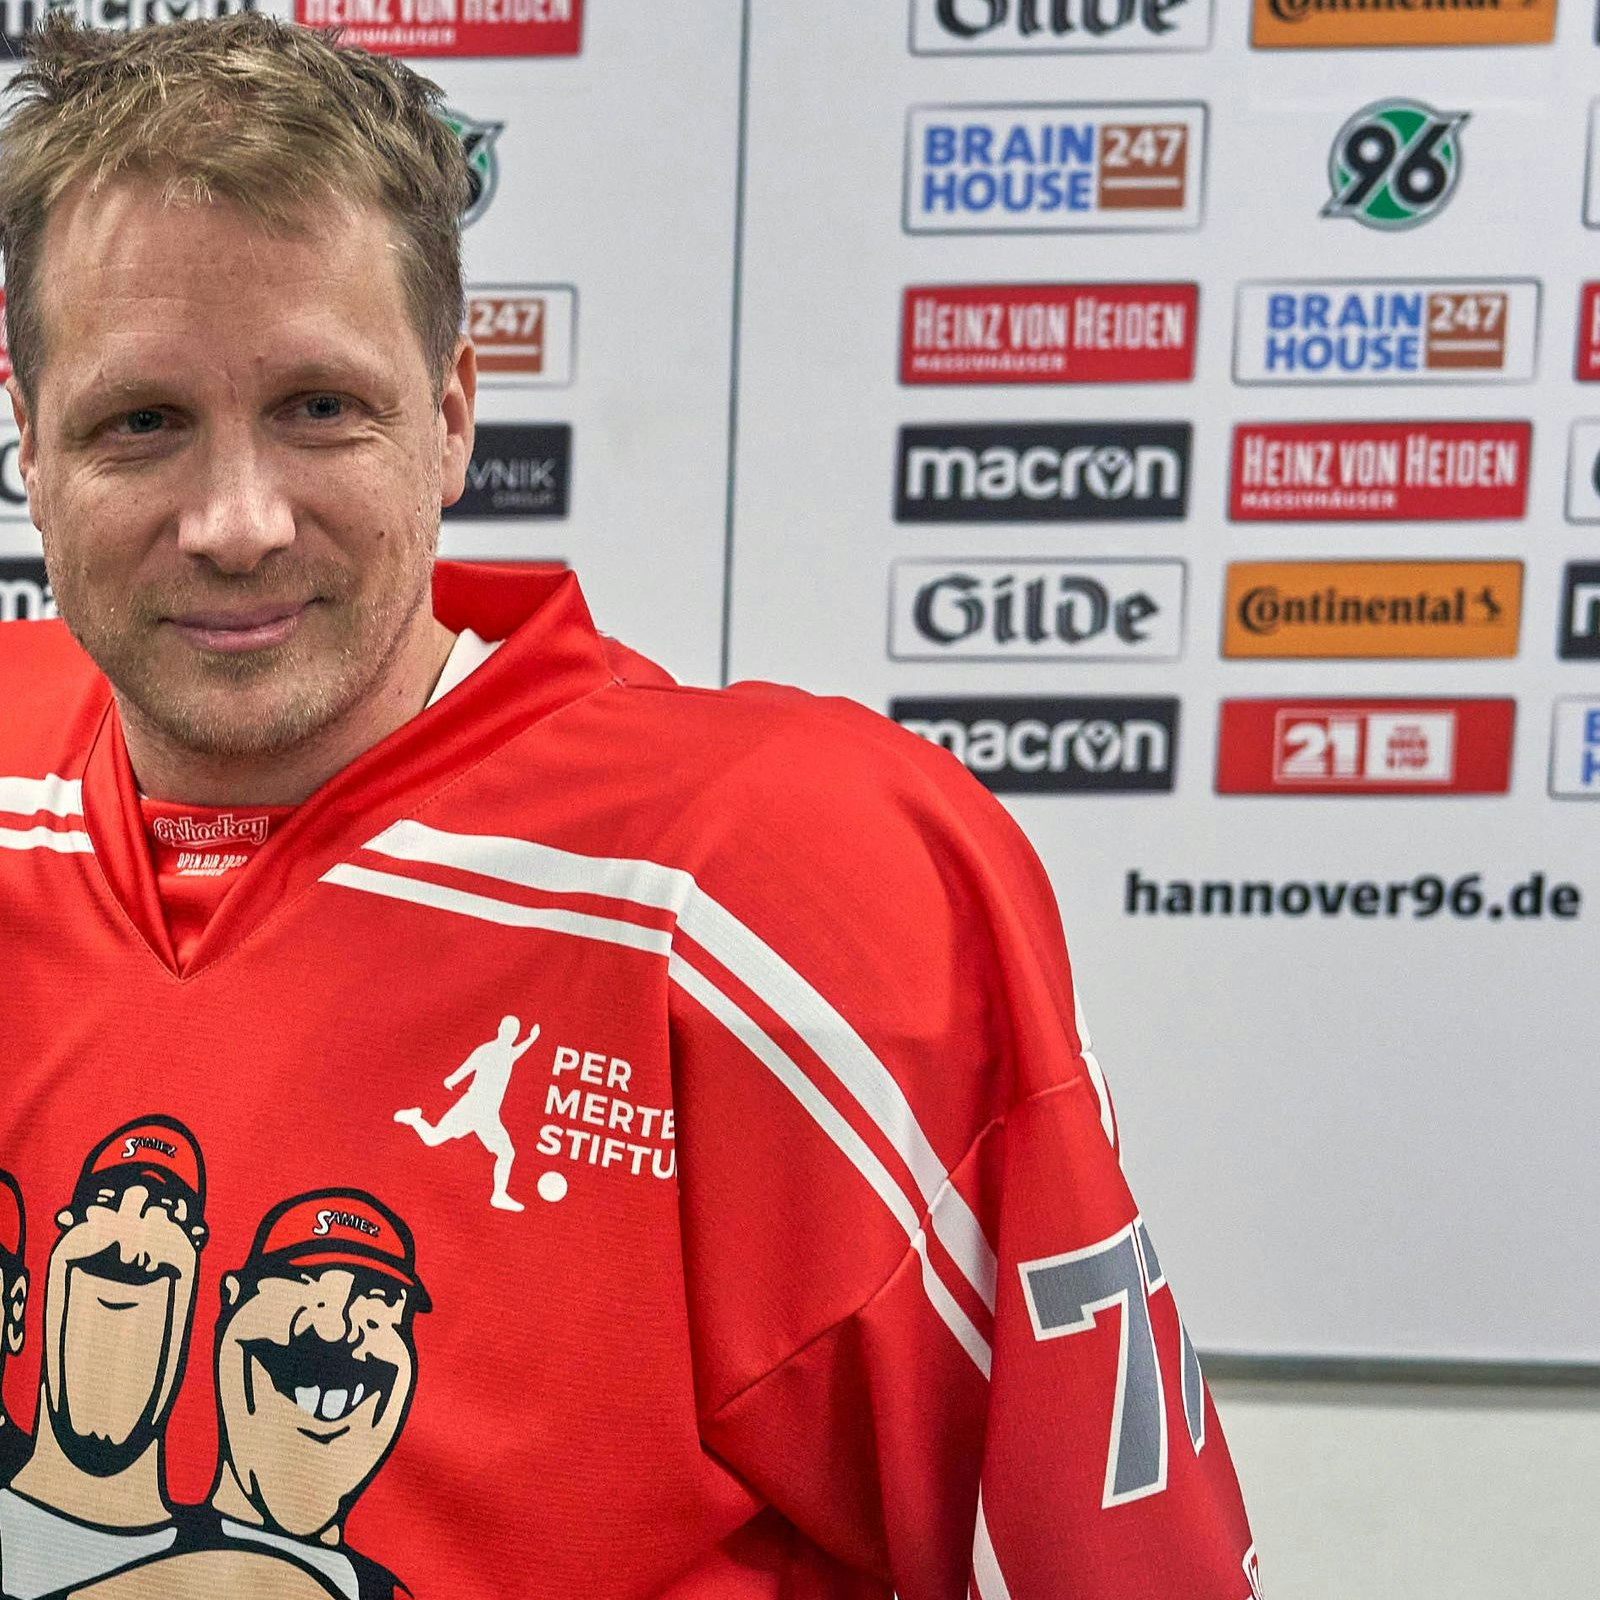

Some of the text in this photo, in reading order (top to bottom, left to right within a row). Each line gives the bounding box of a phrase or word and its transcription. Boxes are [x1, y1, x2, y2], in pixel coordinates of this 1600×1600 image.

[923, 125, 1182, 166] BRAIN 247
[1342, 122, 1448, 206] 96
[923, 172, 1092, 212] HOUSE
[471, 303, 540, 337] 247
[913, 296, 1185, 349] HEINZ VON HEIDEN
[1267, 294, 1499, 331] BRAIN 247
[1266, 337, 1420, 371] HOUSE
[469, 457, 557, 490] VNIK
[905, 446, 1180, 500] macron
[1242, 434, 1519, 487] HEINZ VON HEIDEN
[912, 573, 1161, 646] Gilde
[1236, 585, 1466, 635] Continental
[1282, 721, 1359, 778] 21
[1124, 869, 1581, 921] hannover96.de
[552, 1046, 632, 1093] PER
[544, 1085, 676, 1140] MERTE
[536, 1124, 679, 1180] STIFTU
